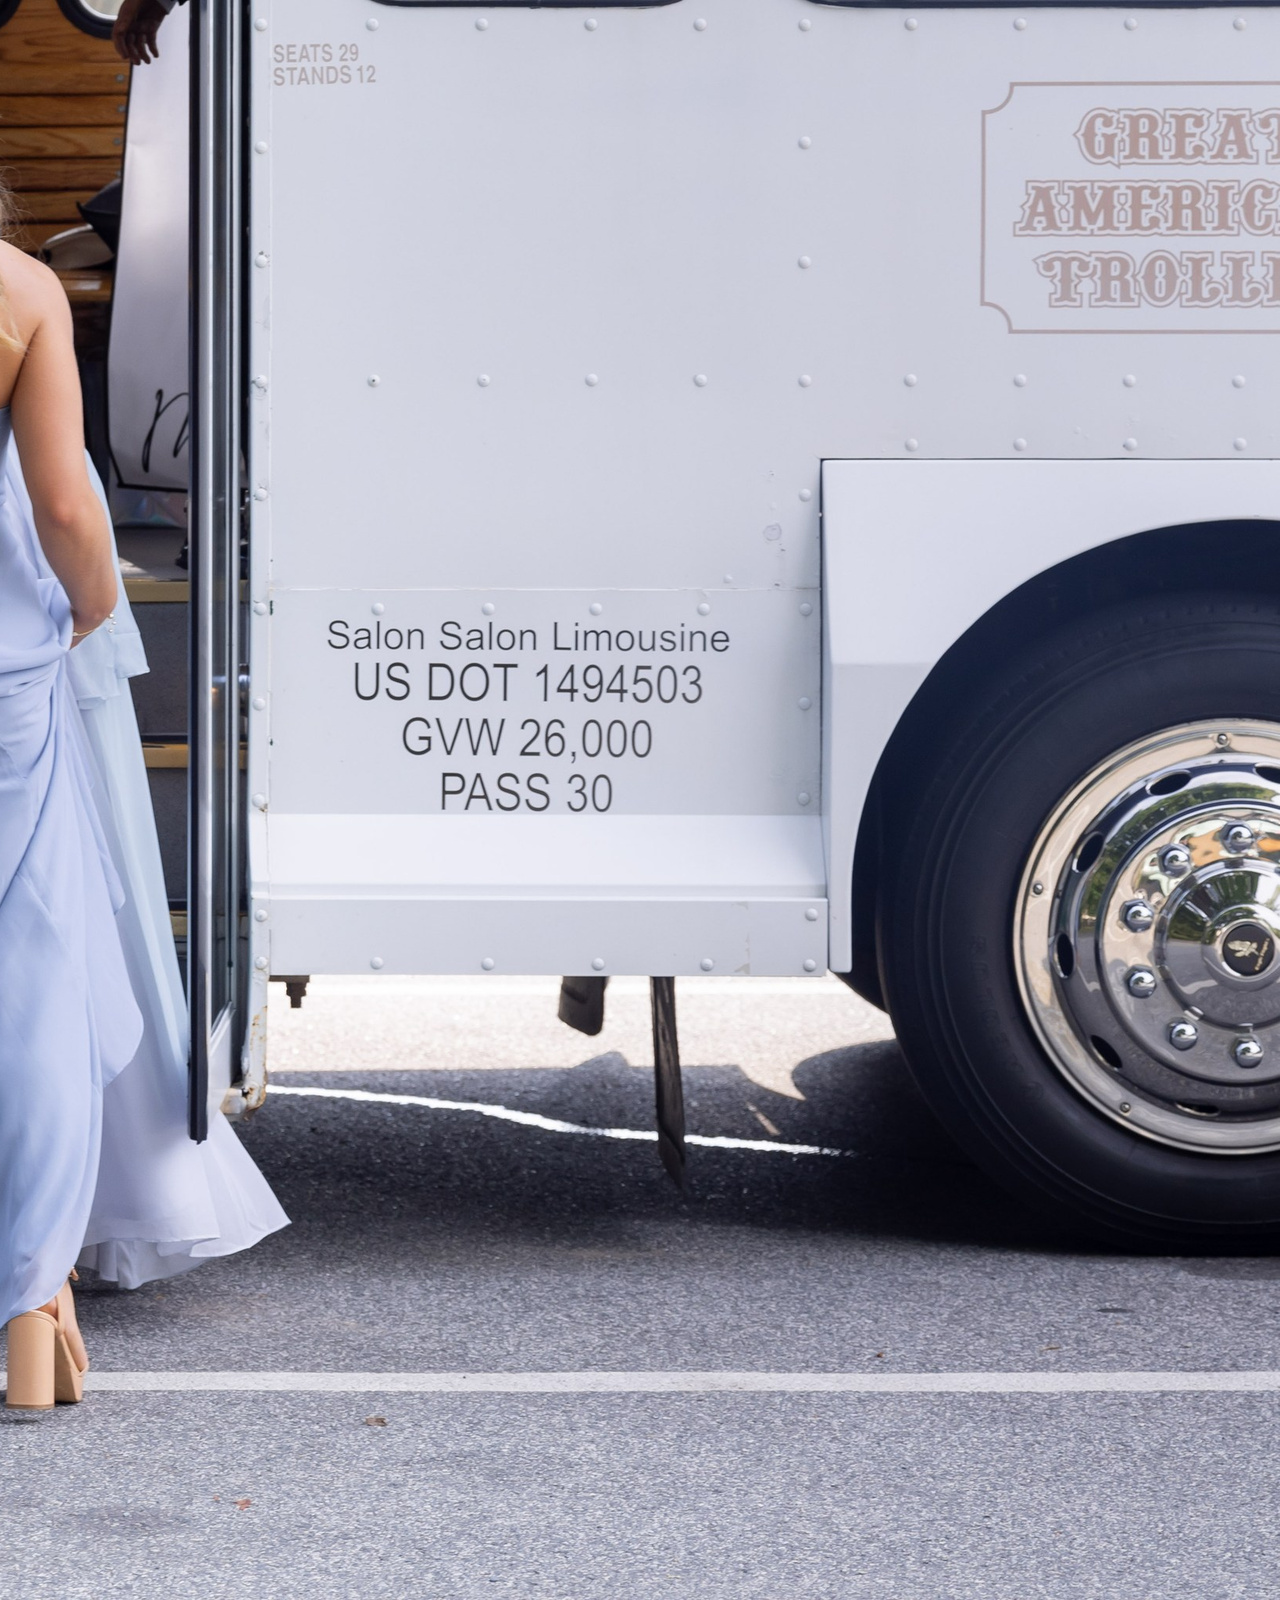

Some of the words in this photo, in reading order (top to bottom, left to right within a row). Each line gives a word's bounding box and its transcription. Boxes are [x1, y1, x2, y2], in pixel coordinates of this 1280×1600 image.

[273, 43, 333, 63] SEATS
[339, 43, 359, 62] 29
[273, 64, 352, 86] STANDS
[357, 64, 376, 83] 12
[1013, 178, 1280, 237] AMERIC
[326, 619, 425, 651] Salon
[439, 620, 537, 651] Salon
[553, 621, 731, 653] Limousine
[353, 661, 411, 703] US
[427, 662, 519, 702] DOT
[535, 663, 704, 705] 1494503
[401, 716, 506, 757] GVW
[518, 718, 653, 764] 26,000
[440, 771, 551, 813] PASS
[566, 773, 613, 813] 30
